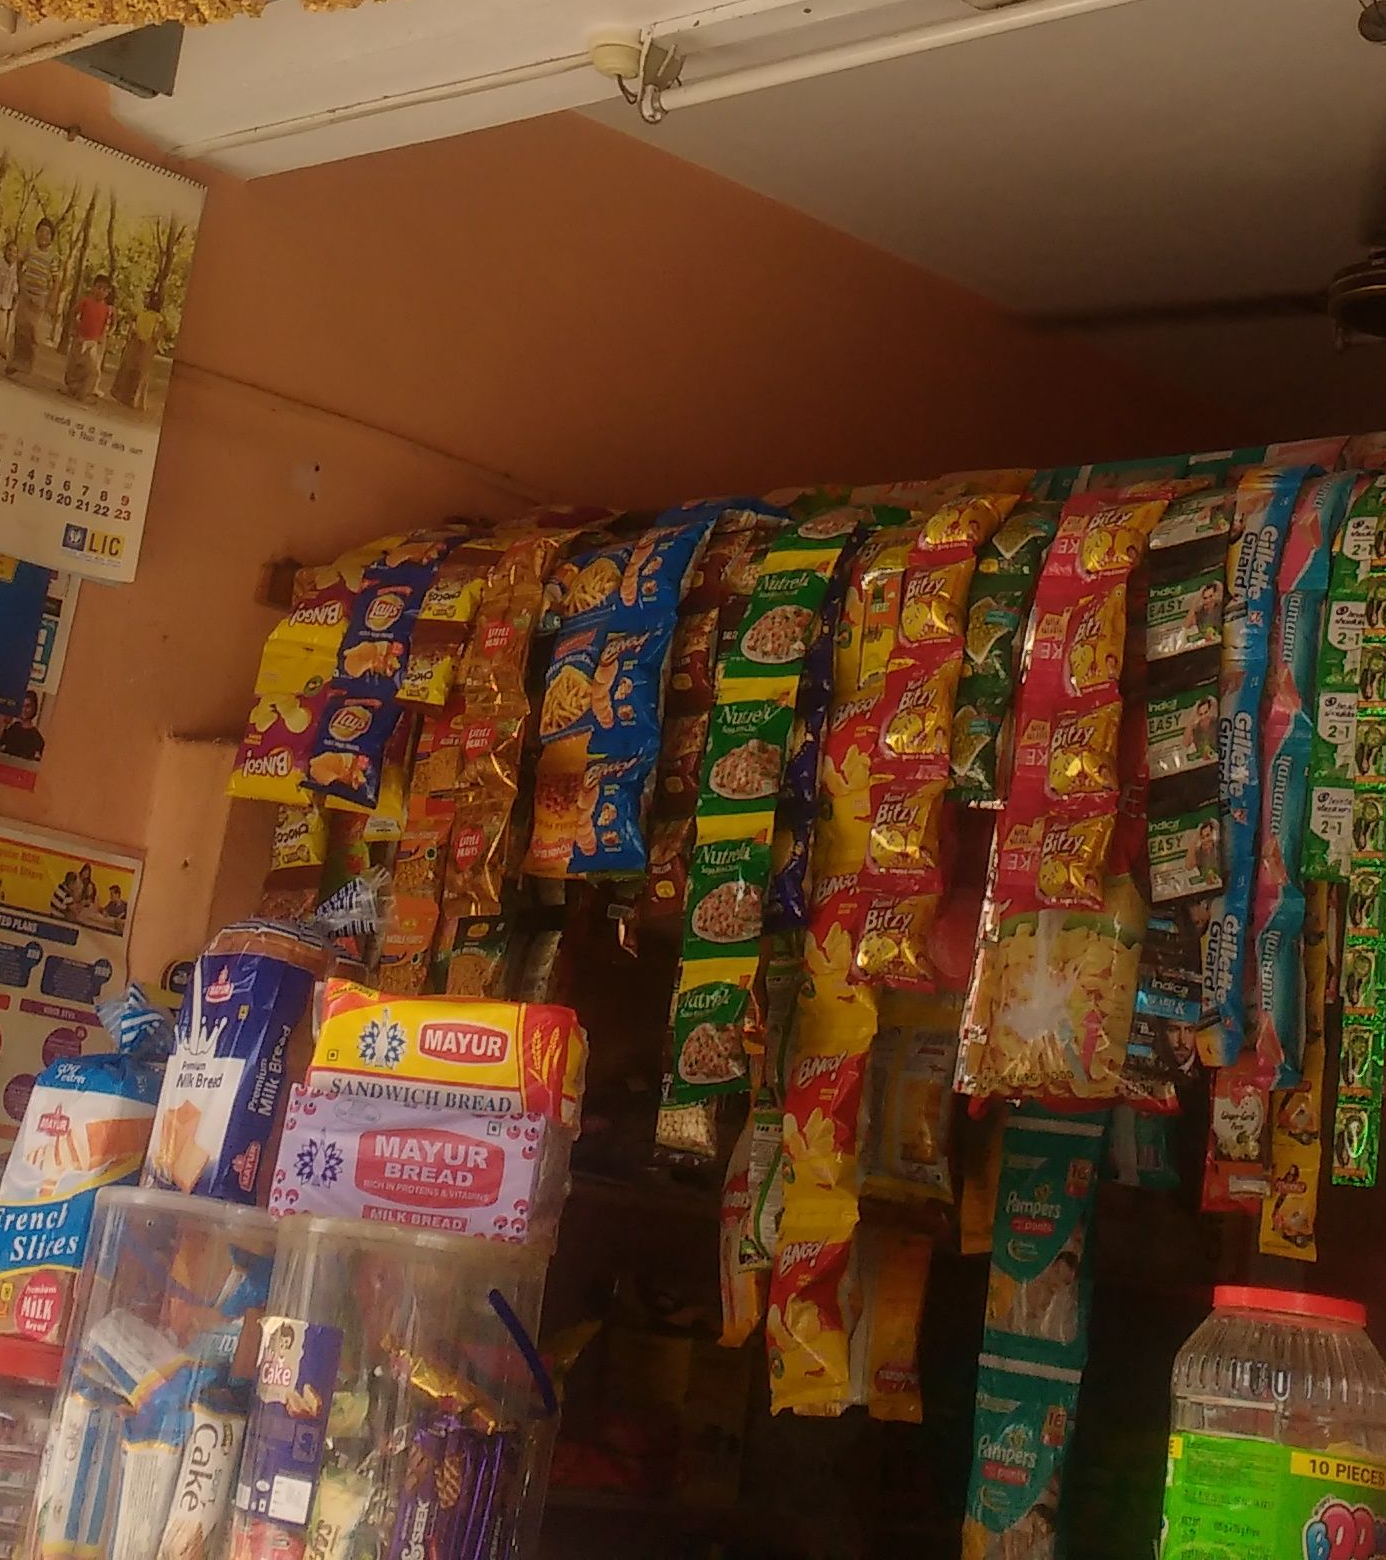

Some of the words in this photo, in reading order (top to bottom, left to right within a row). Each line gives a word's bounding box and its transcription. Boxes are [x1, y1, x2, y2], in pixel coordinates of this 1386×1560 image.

[11, 463, 19, 473] 3
[28, 469, 35, 479] 4
[45, 475, 53, 485] 5
[63, 480, 71, 491] 6
[82, 485, 89, 496] 7
[100, 491, 108, 501] 8
[120, 495, 130, 506] 9
[1, 491, 16, 505] 31
[4, 476, 18, 489] 17
[21, 481, 35, 495] 18
[38, 487, 53, 501] 19
[56, 493, 72, 506] 20
[75, 499, 90, 512] 21
[93, 503, 110, 517] 22
[113, 508, 132, 521] 23
[87, 531, 122, 557] LIC
[906, 578, 945, 598] Bitzy
[1149, 597, 1186, 618] EASY
[1149, 714, 1182, 733] EASY
[1052, 725, 1095, 750] Bitzy
[875, 804, 920, 826] Bitzy
[1042, 834, 1085, 857] Bitzy
[1150, 835, 1184, 854] EASY
[865, 908, 914, 931] Bitzy
[423, 1028, 503, 1058] MAYUR
[258, 1076, 280, 1118] Milk
[272, 1025, 292, 1073] Bread
[247, 1057, 269, 1113] Premium
[330, 1077, 439, 1110] SANDWICH
[445, 1092, 512, 1114] BREAD
[373, 1134, 488, 1170] MAYUR
[383, 1164, 474, 1188] BREAD
[1005, 1190, 1062, 1220] Pampers
[369, 1208, 407, 1225] MILK
[410, 1211, 464, 1231] BREAD
[260, 1362, 293, 1387] Cake
[977, 1435, 1037, 1467] Pampers
[1308, 1458, 1330, 1476] 10
[1336, 1464, 1386, 1485] PIECES
